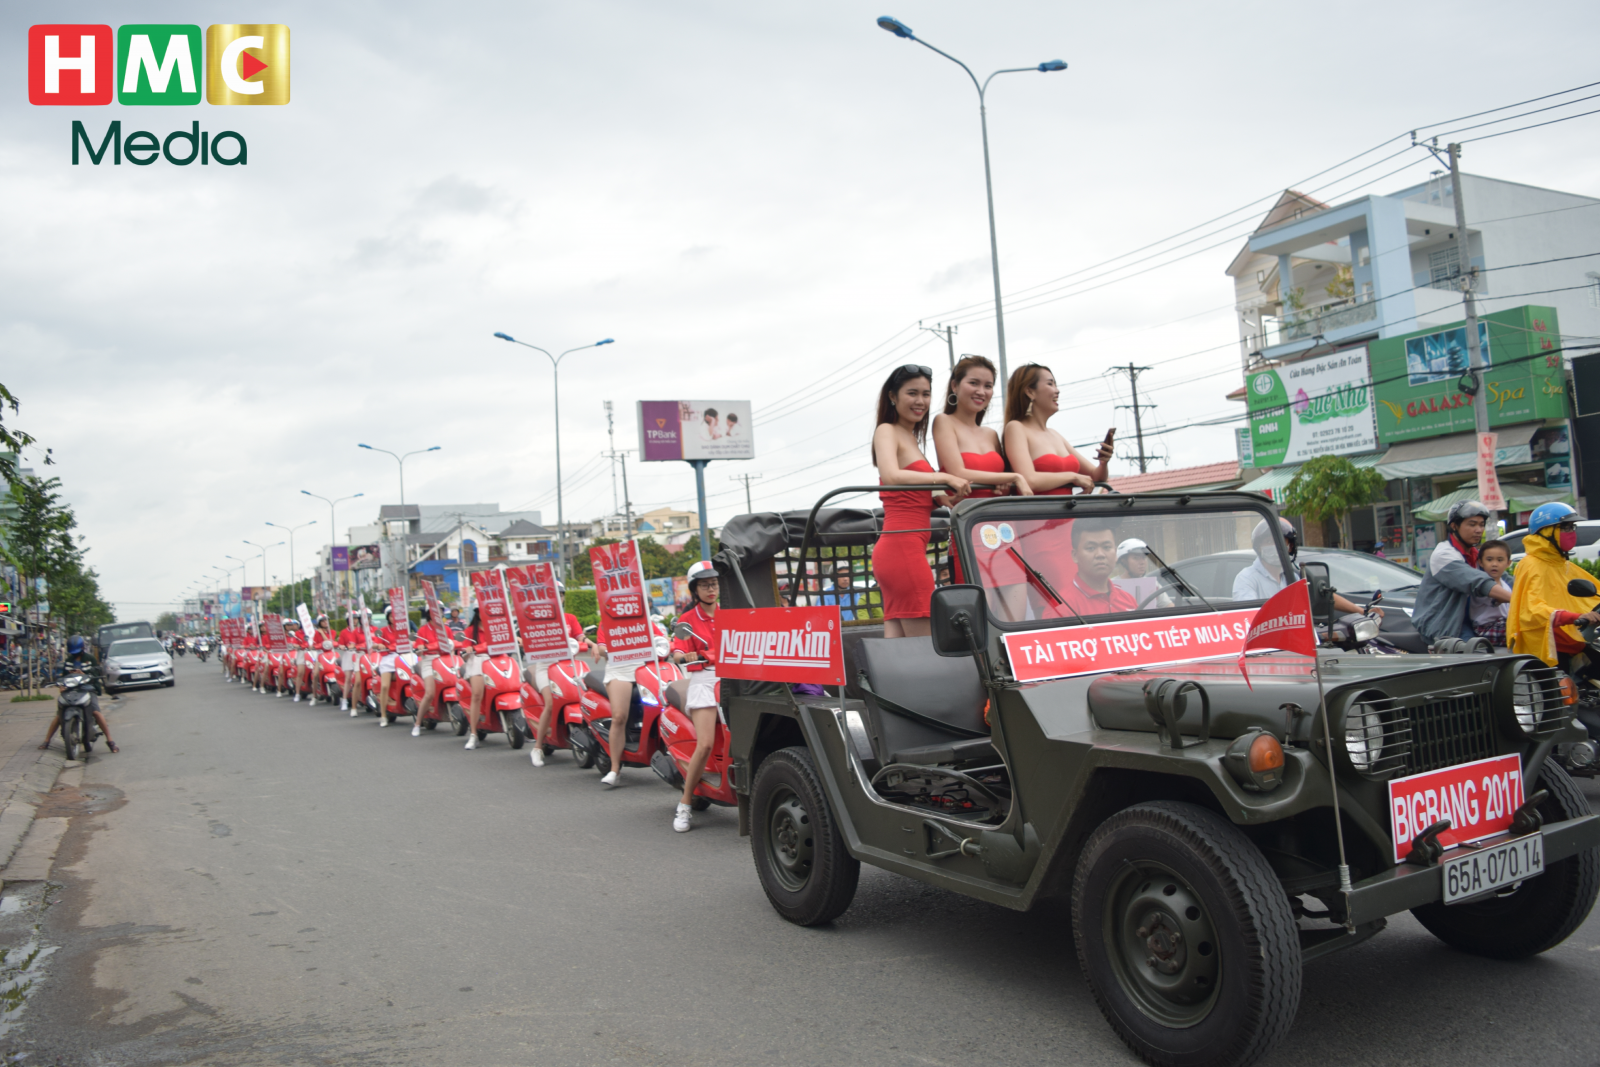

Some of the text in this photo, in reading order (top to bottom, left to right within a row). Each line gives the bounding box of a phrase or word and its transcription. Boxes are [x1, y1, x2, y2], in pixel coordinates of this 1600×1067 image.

[1301, 366, 1315, 376] Hàng
[1339, 358, 1347, 368] An
[1406, 381, 1525, 418] GALAXY Spa
[647, 429, 677, 439] TPBank
[1258, 422, 1278, 435] ANH
[601, 553, 629, 571] BIG
[520, 571, 545, 587] BIG
[598, 571, 640, 593] BANG
[516, 587, 555, 603] BANG
[489, 623, 509, 632] 01/12
[523, 628, 563, 639] 1.000.000
[609, 622, 646, 637] ĐIỆN MÁY
[491, 633, 510, 642] 2017
[611, 635, 649, 648] GIA DỤNG
[718, 620, 831, 665] NguyenKim
[1020, 639, 1055, 665] TÀI
[1056, 638, 1098, 662] TRỢ
[1101, 632, 1153, 657] TRỰC
[1153, 625, 1191, 649] TIẾP
[1193, 624, 1234, 645] MUA
[1393, 770, 1520, 845] BIGBANG 2017
[1447, 838, 1541, 897] 65A-070.14
